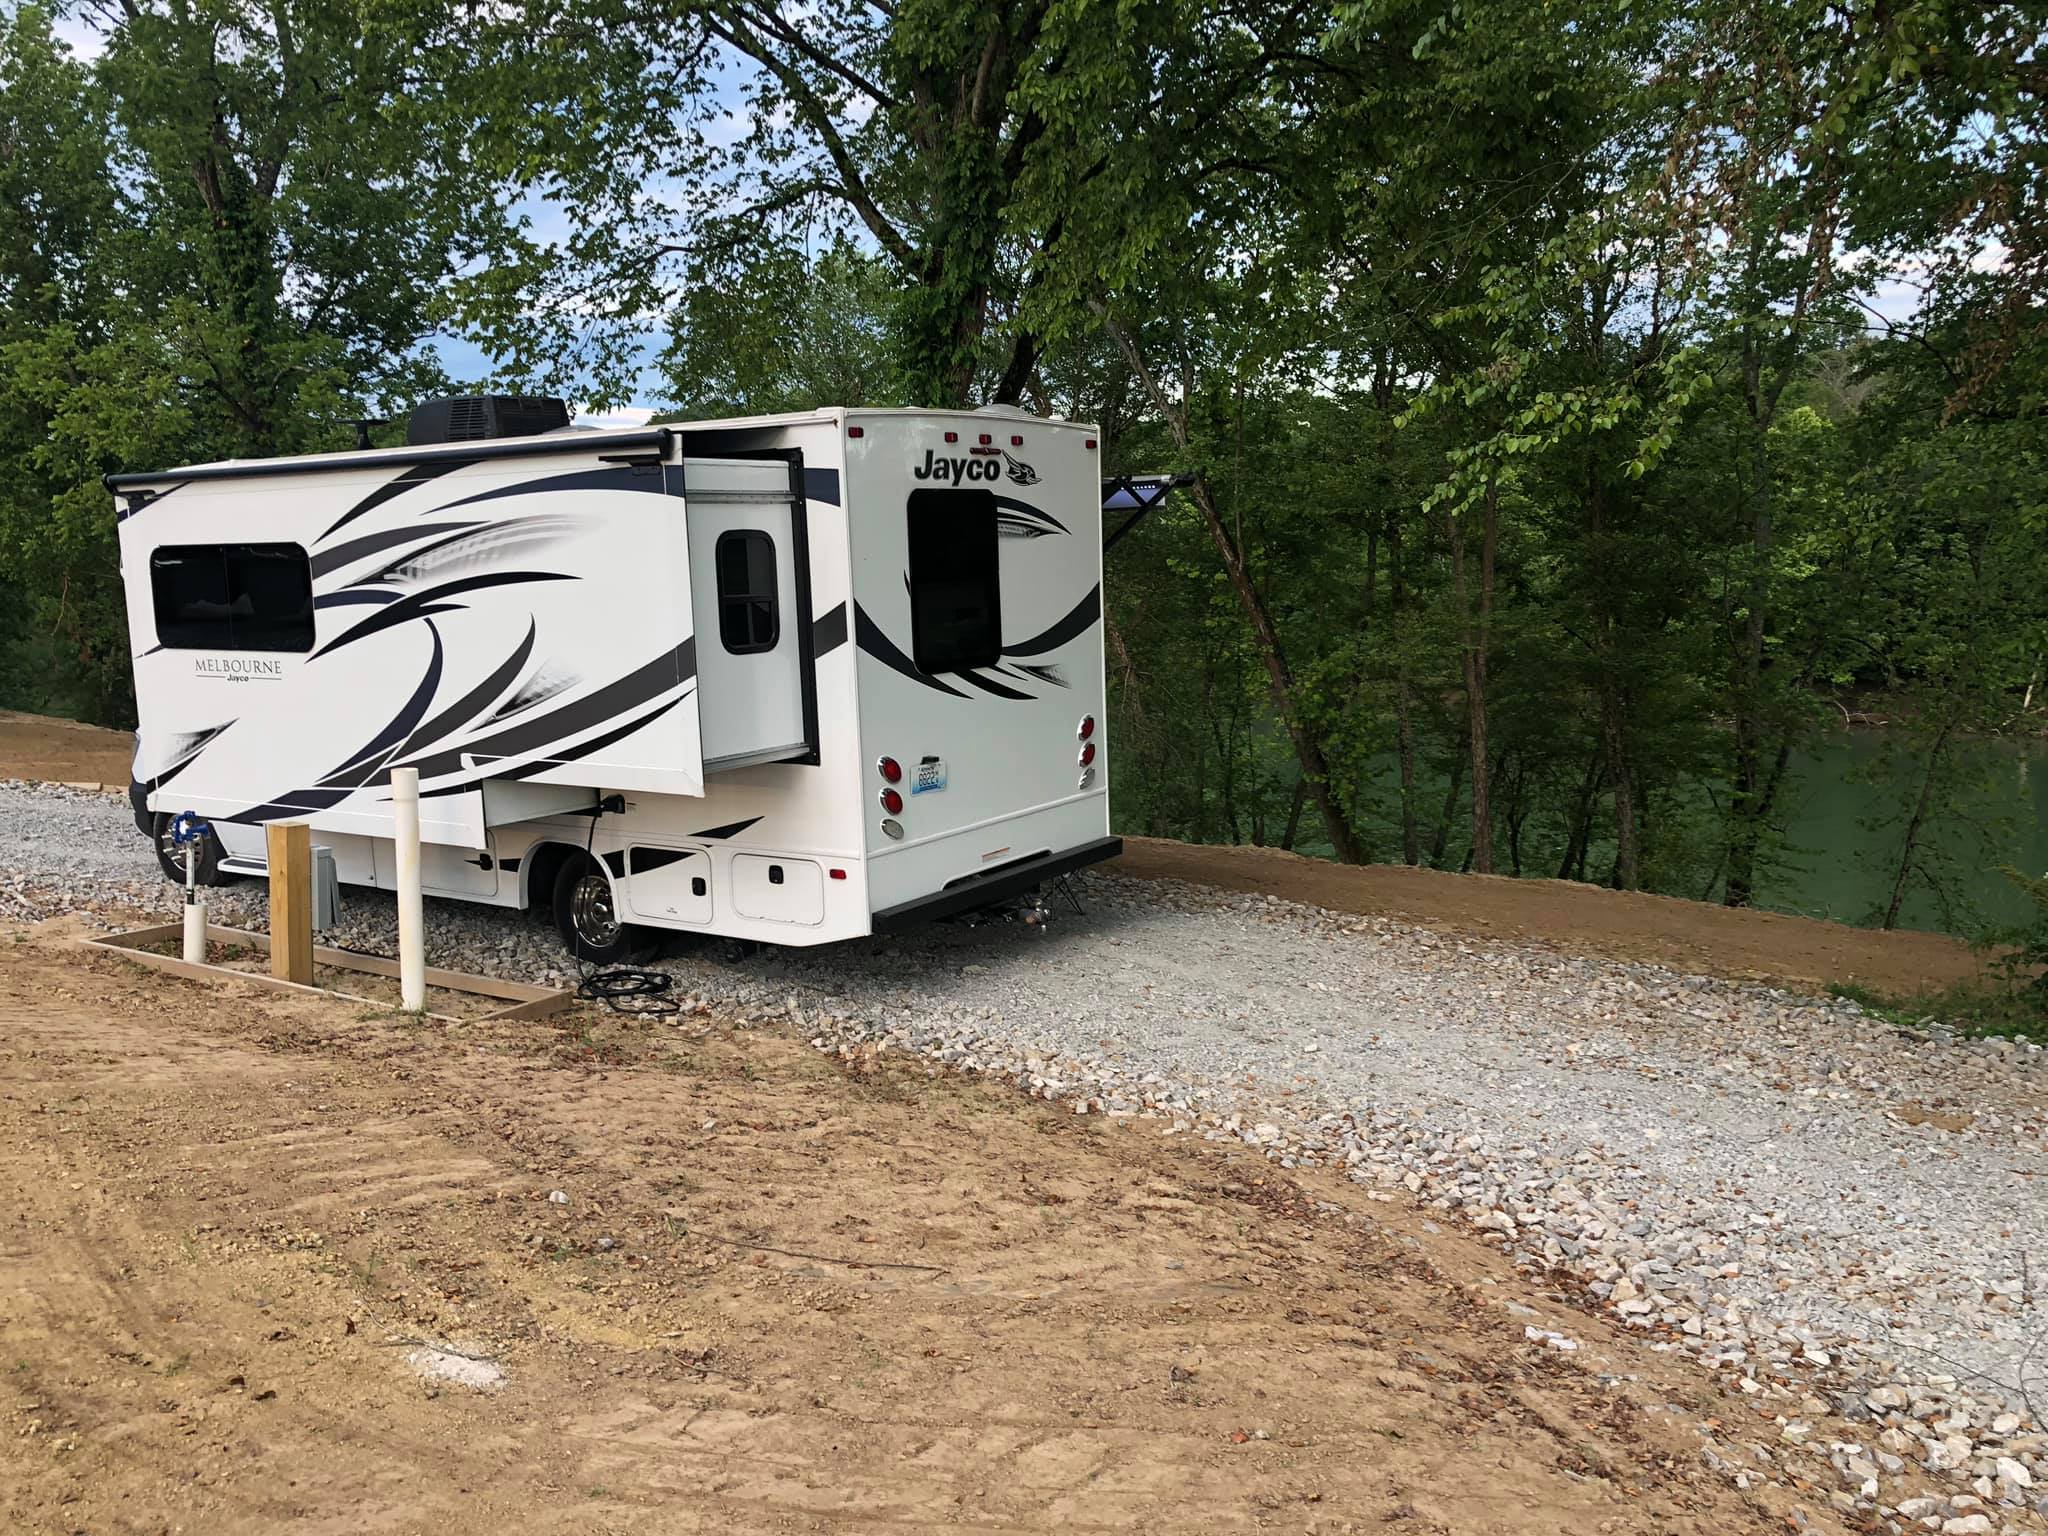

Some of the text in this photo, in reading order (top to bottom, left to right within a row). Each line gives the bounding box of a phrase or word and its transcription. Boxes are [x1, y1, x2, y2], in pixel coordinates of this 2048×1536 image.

[914, 449, 1001, 487] Jayco
[195, 659, 282, 674] MELBOURNE
[227, 674, 249, 683] Jayco
